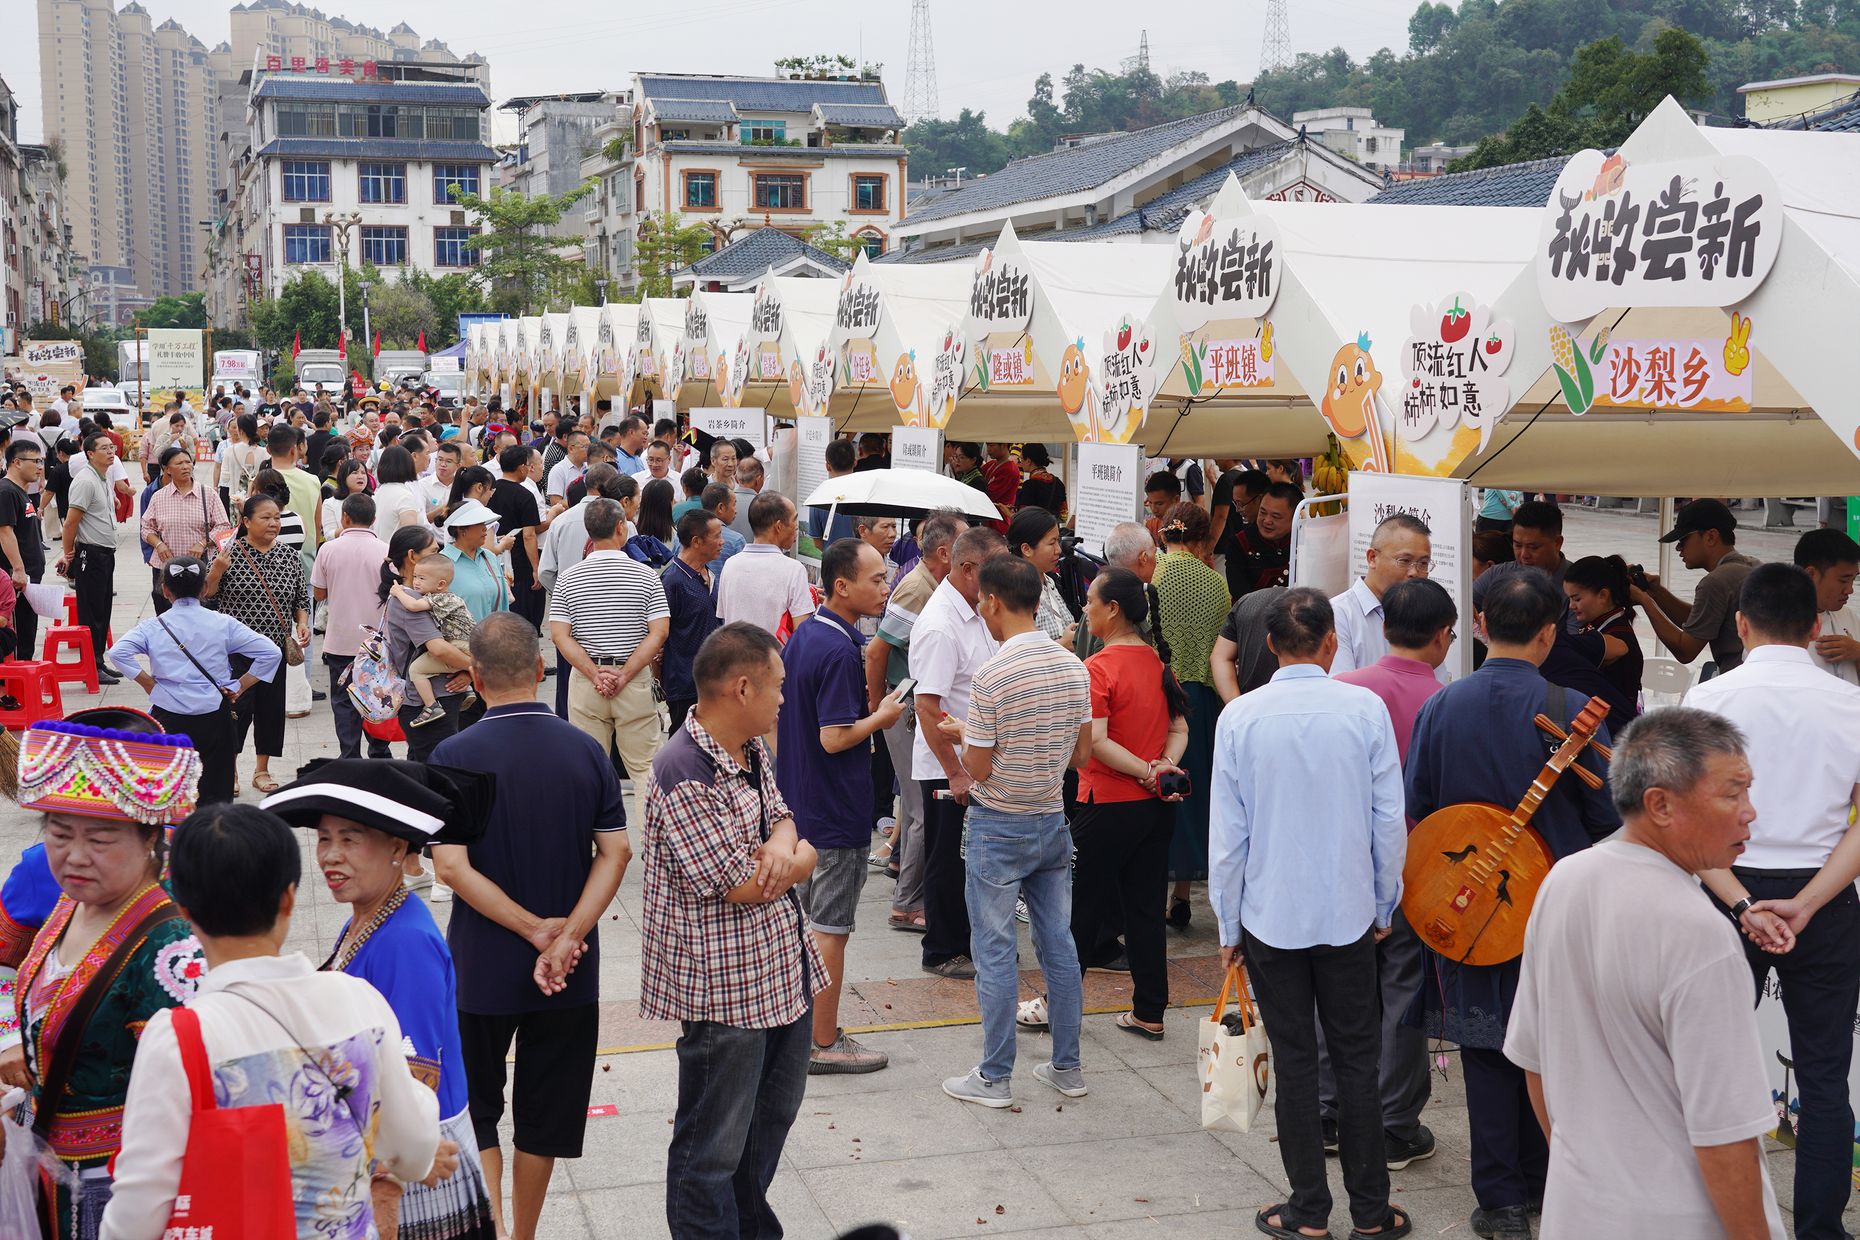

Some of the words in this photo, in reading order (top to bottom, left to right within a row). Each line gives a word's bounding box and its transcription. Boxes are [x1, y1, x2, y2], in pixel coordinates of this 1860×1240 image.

[266, 55, 377, 77] 百里香美食
[1548, 174, 1763, 286] 秋收尝新
[1175, 227, 1274, 305] 秋收尝新
[992, 352, 1023, 382] 隆或镇
[1104, 342, 1143, 378] 顶流红人
[1209, 344, 1257, 384] 平班镇
[1412, 337, 1488, 378] 顶流红人
[1610, 346, 1711, 402] 沙梨乡
[1102, 374, 1142, 420] 柿柿如意
[1404, 380, 1482, 428] 柿柿如意
[707, 419, 746, 430] 岩茶乡简介
[1091, 463, 1122, 482] 平班镇简介
